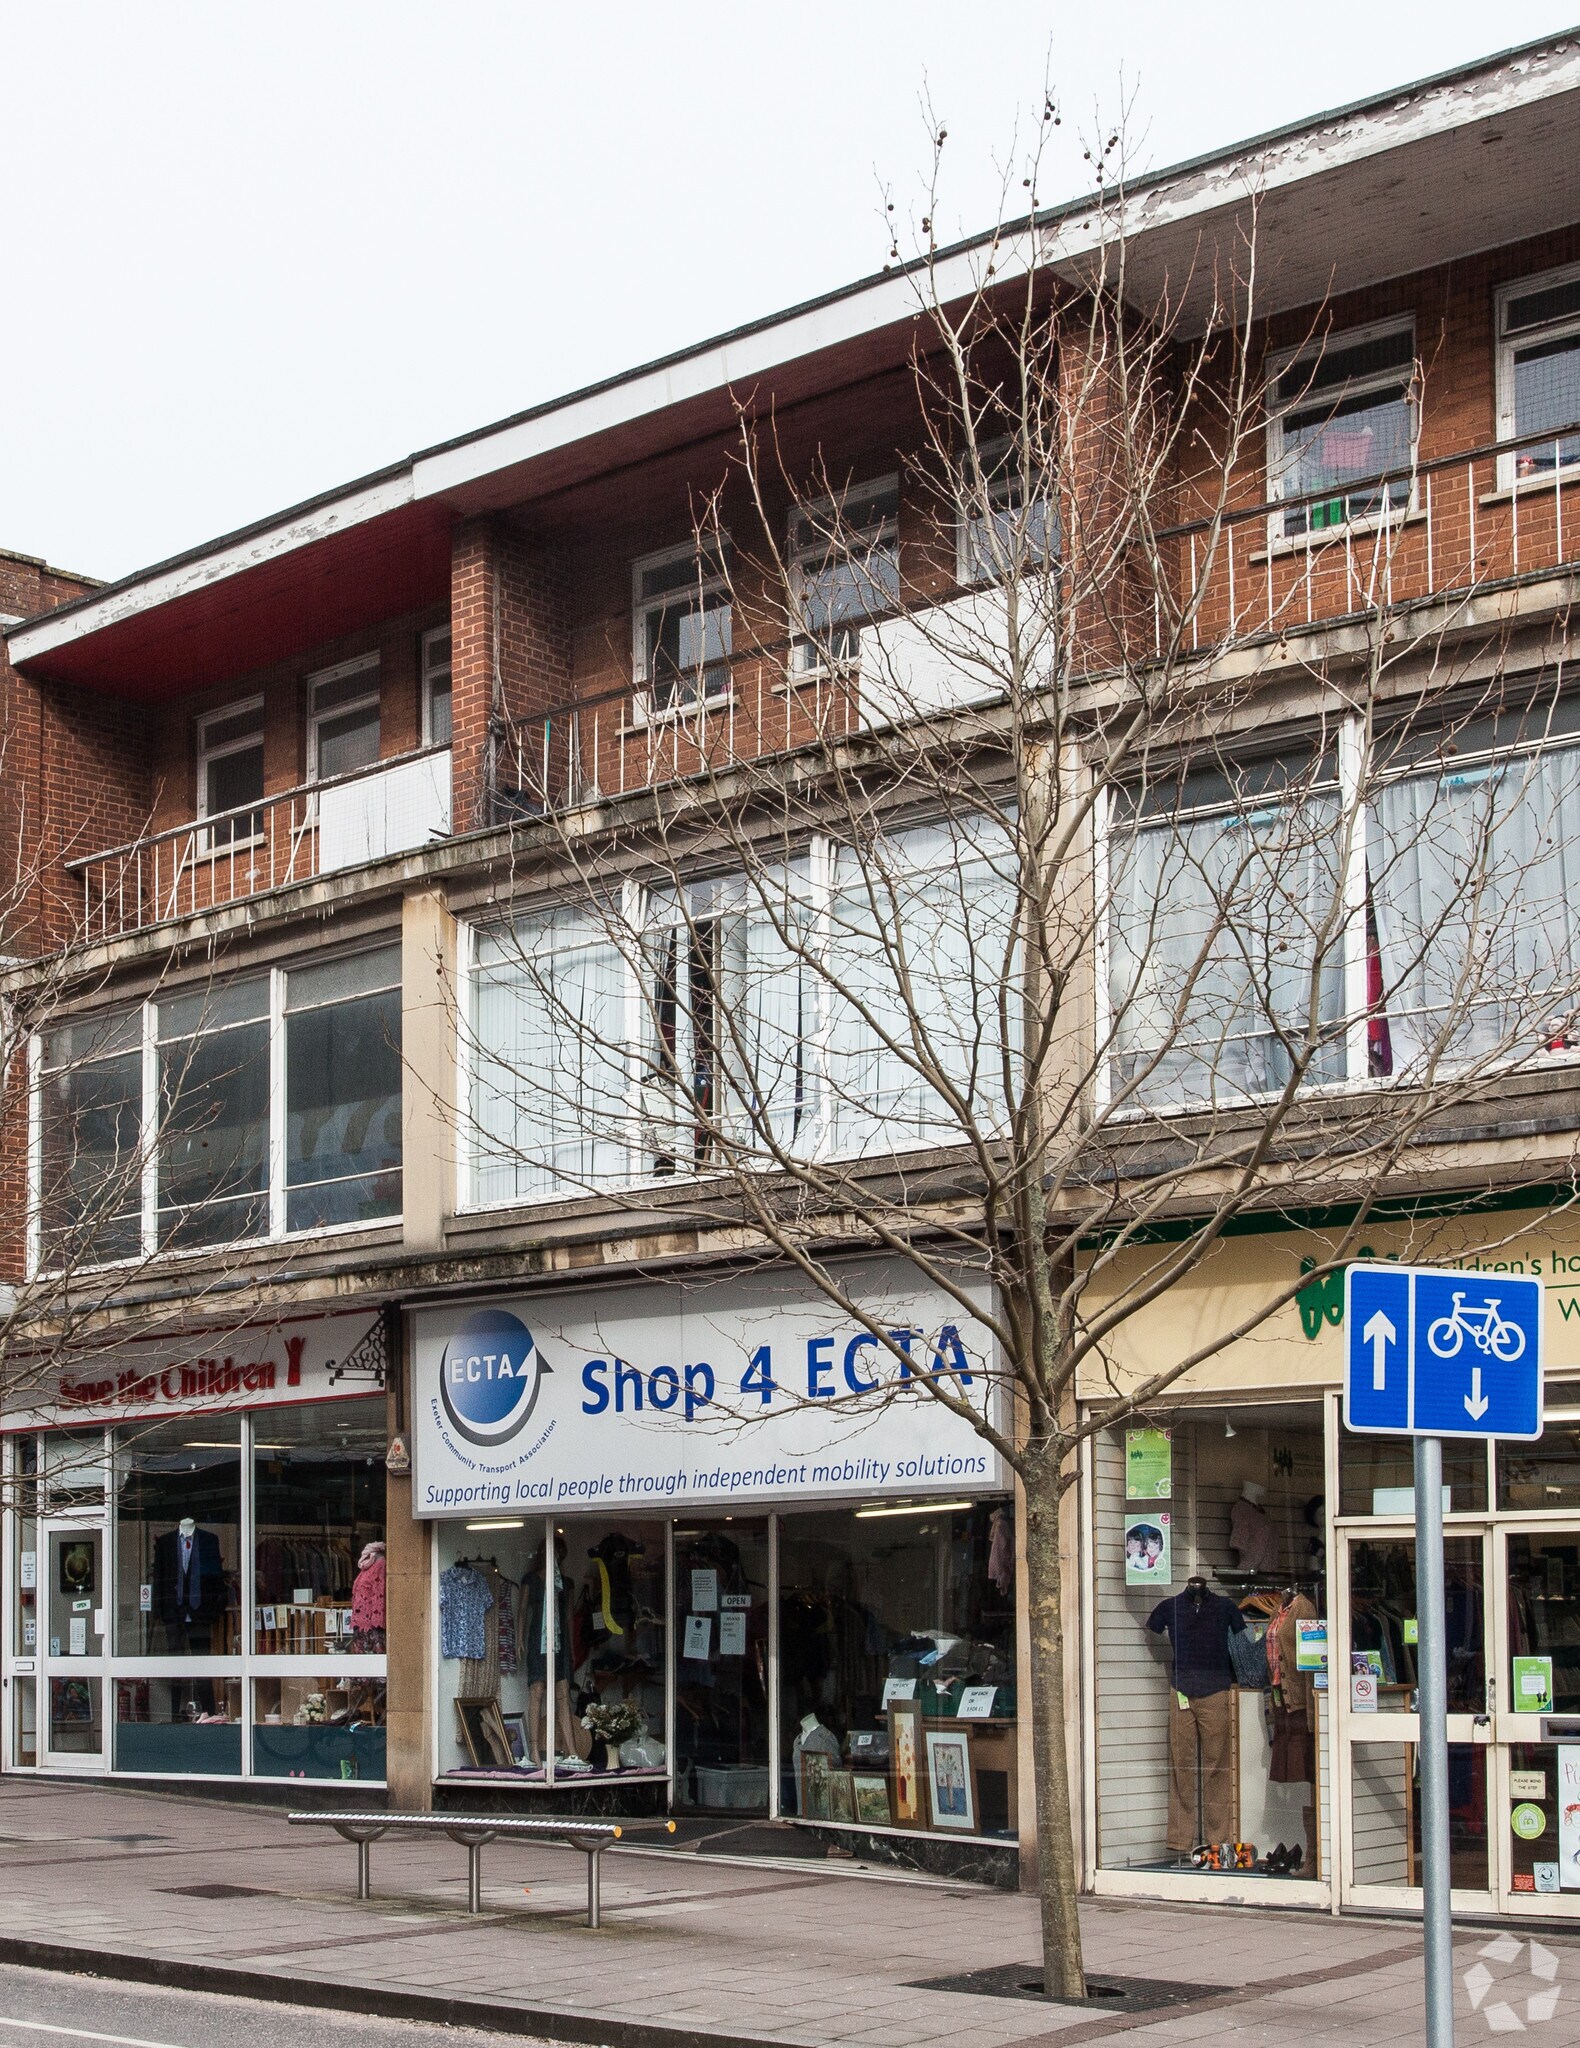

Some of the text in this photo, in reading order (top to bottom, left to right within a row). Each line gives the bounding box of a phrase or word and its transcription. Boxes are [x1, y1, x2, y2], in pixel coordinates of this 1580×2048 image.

[59, 1355, 276, 1411] Save the Children
[451, 1353, 514, 1384] ECTA
[582, 1324, 974, 1423] Shop 4 ECTA
[430, 1398, 557, 1474] Exeter Community Transport Association
[427, 1453, 986, 1507] Supporting local people through independent mobility solutions
[726, 1597, 746, 1605] OPEN
